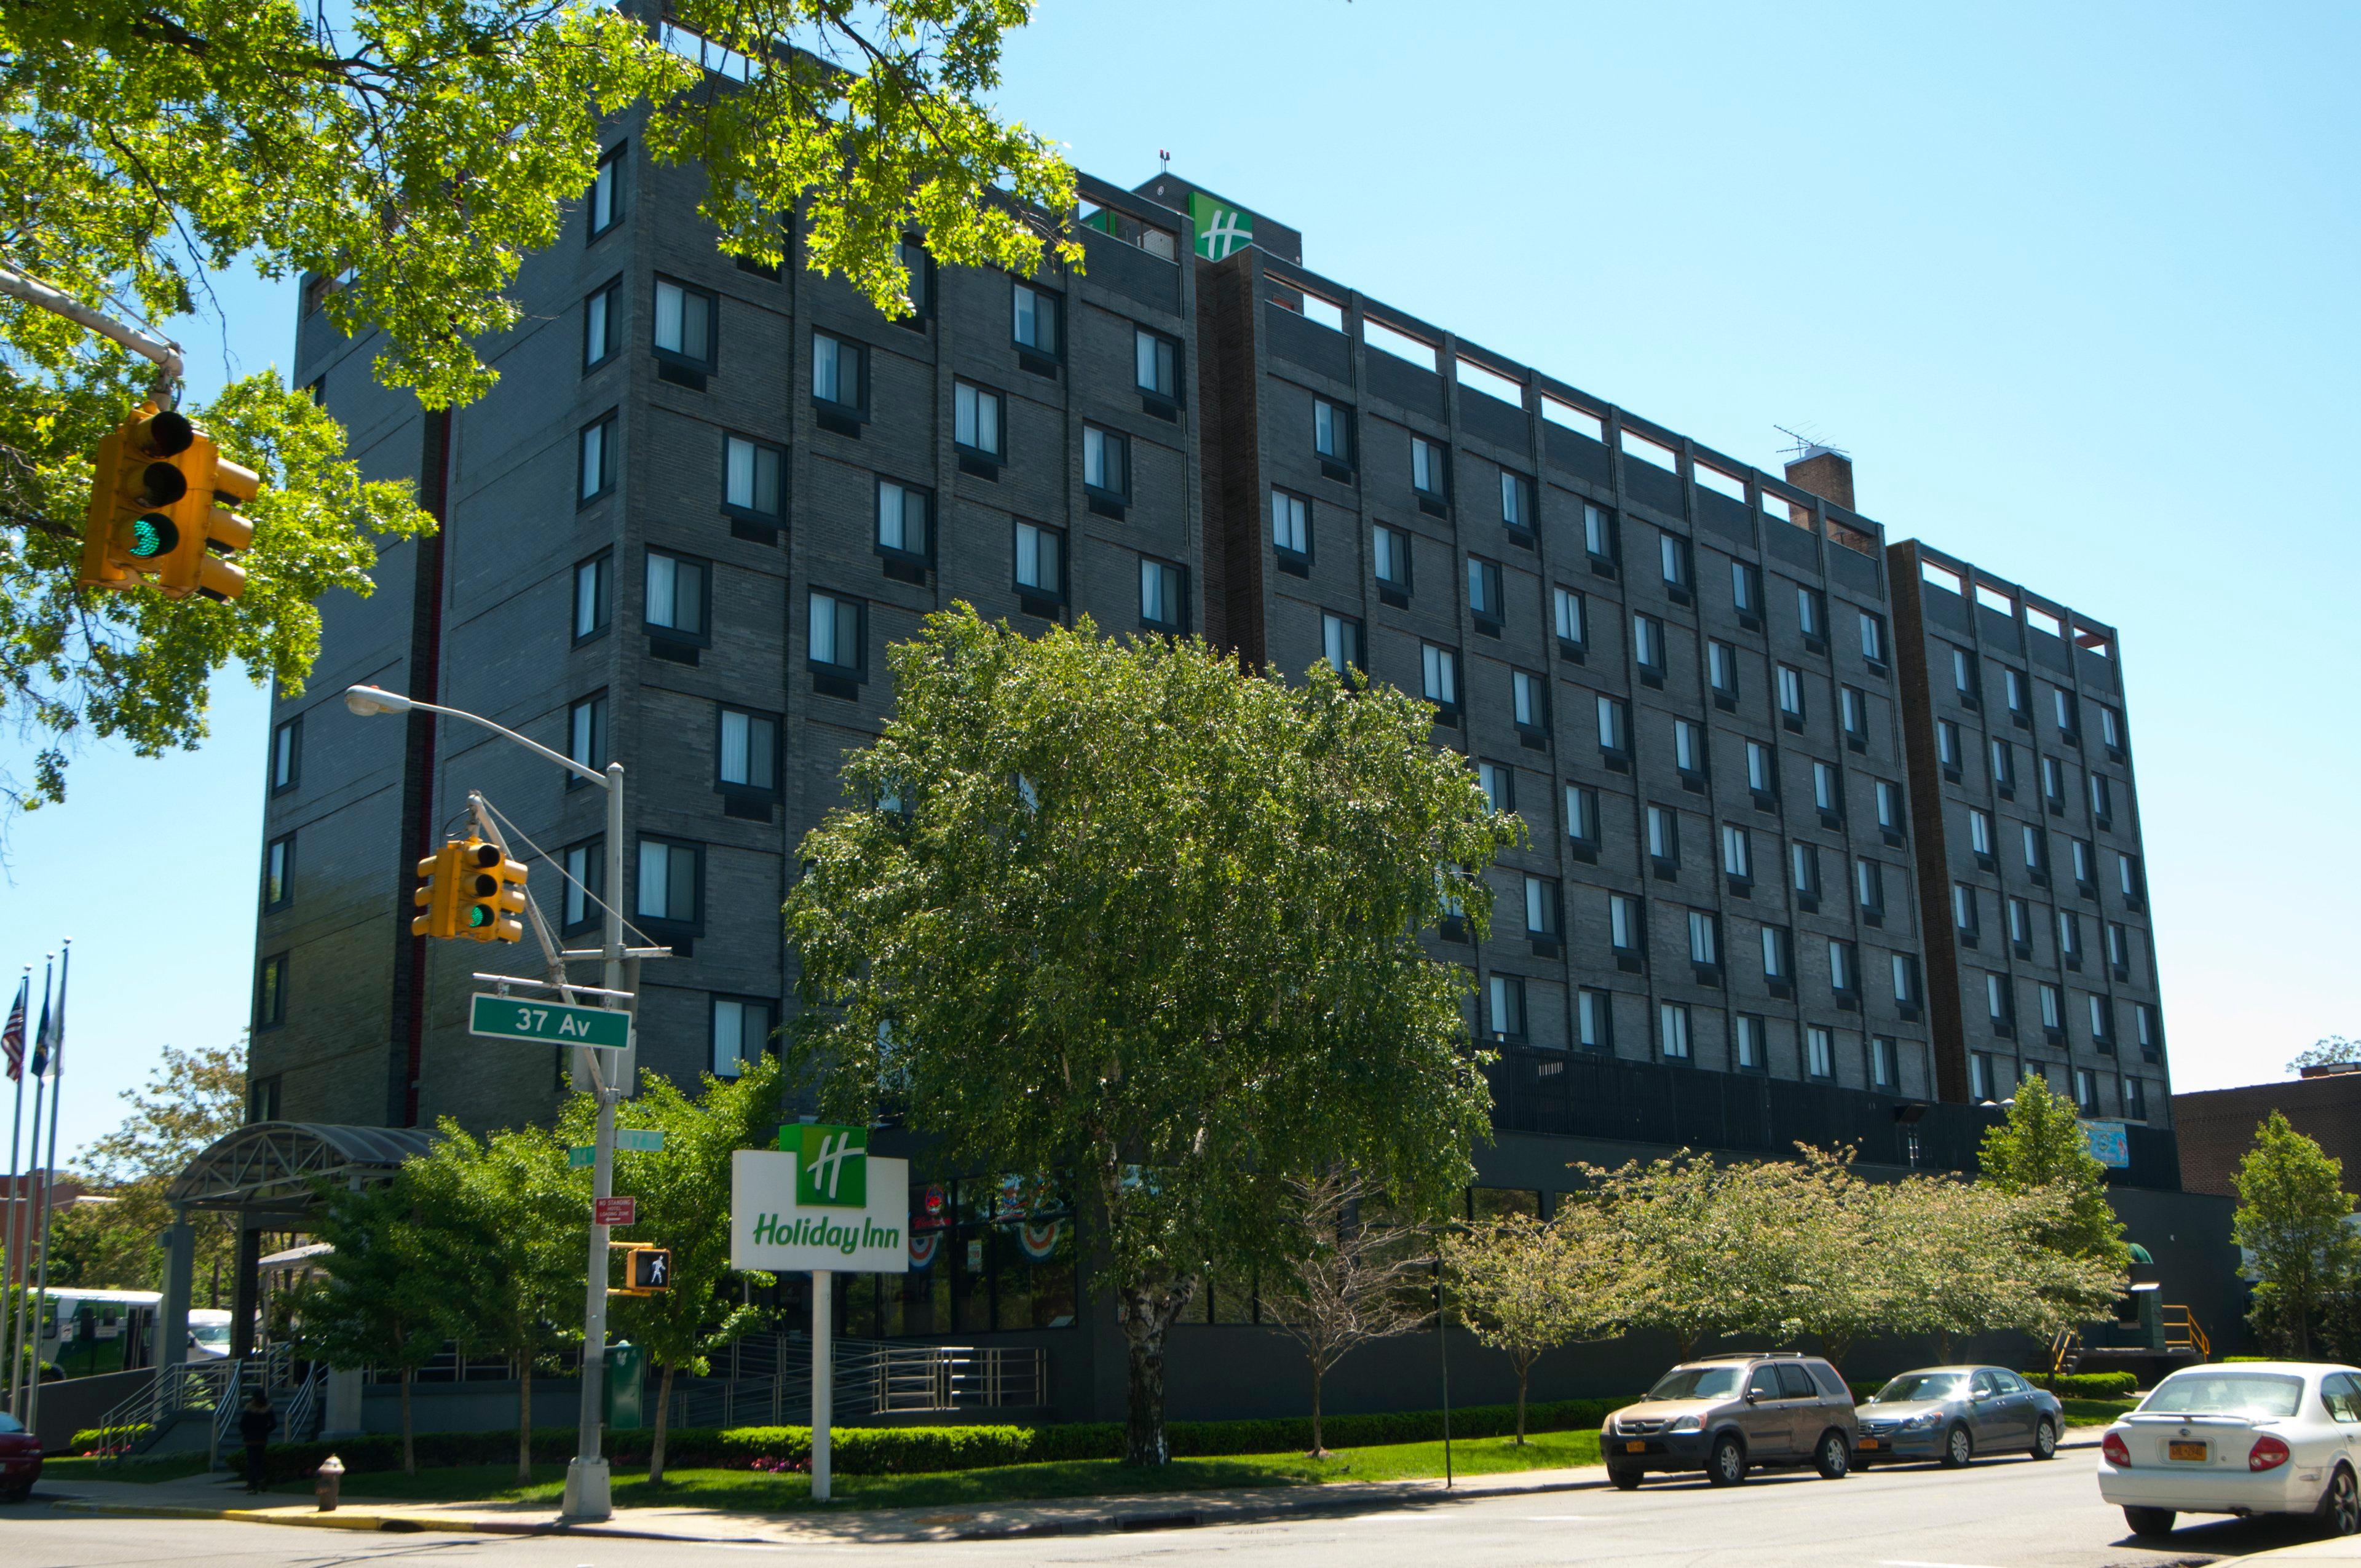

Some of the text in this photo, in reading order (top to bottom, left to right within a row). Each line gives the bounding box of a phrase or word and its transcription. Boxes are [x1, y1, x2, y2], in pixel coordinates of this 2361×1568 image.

[515, 1008, 590, 1037] 37 Av
[807, 1131, 865, 1199] H
[753, 1213, 900, 1254] Holiday Inn
